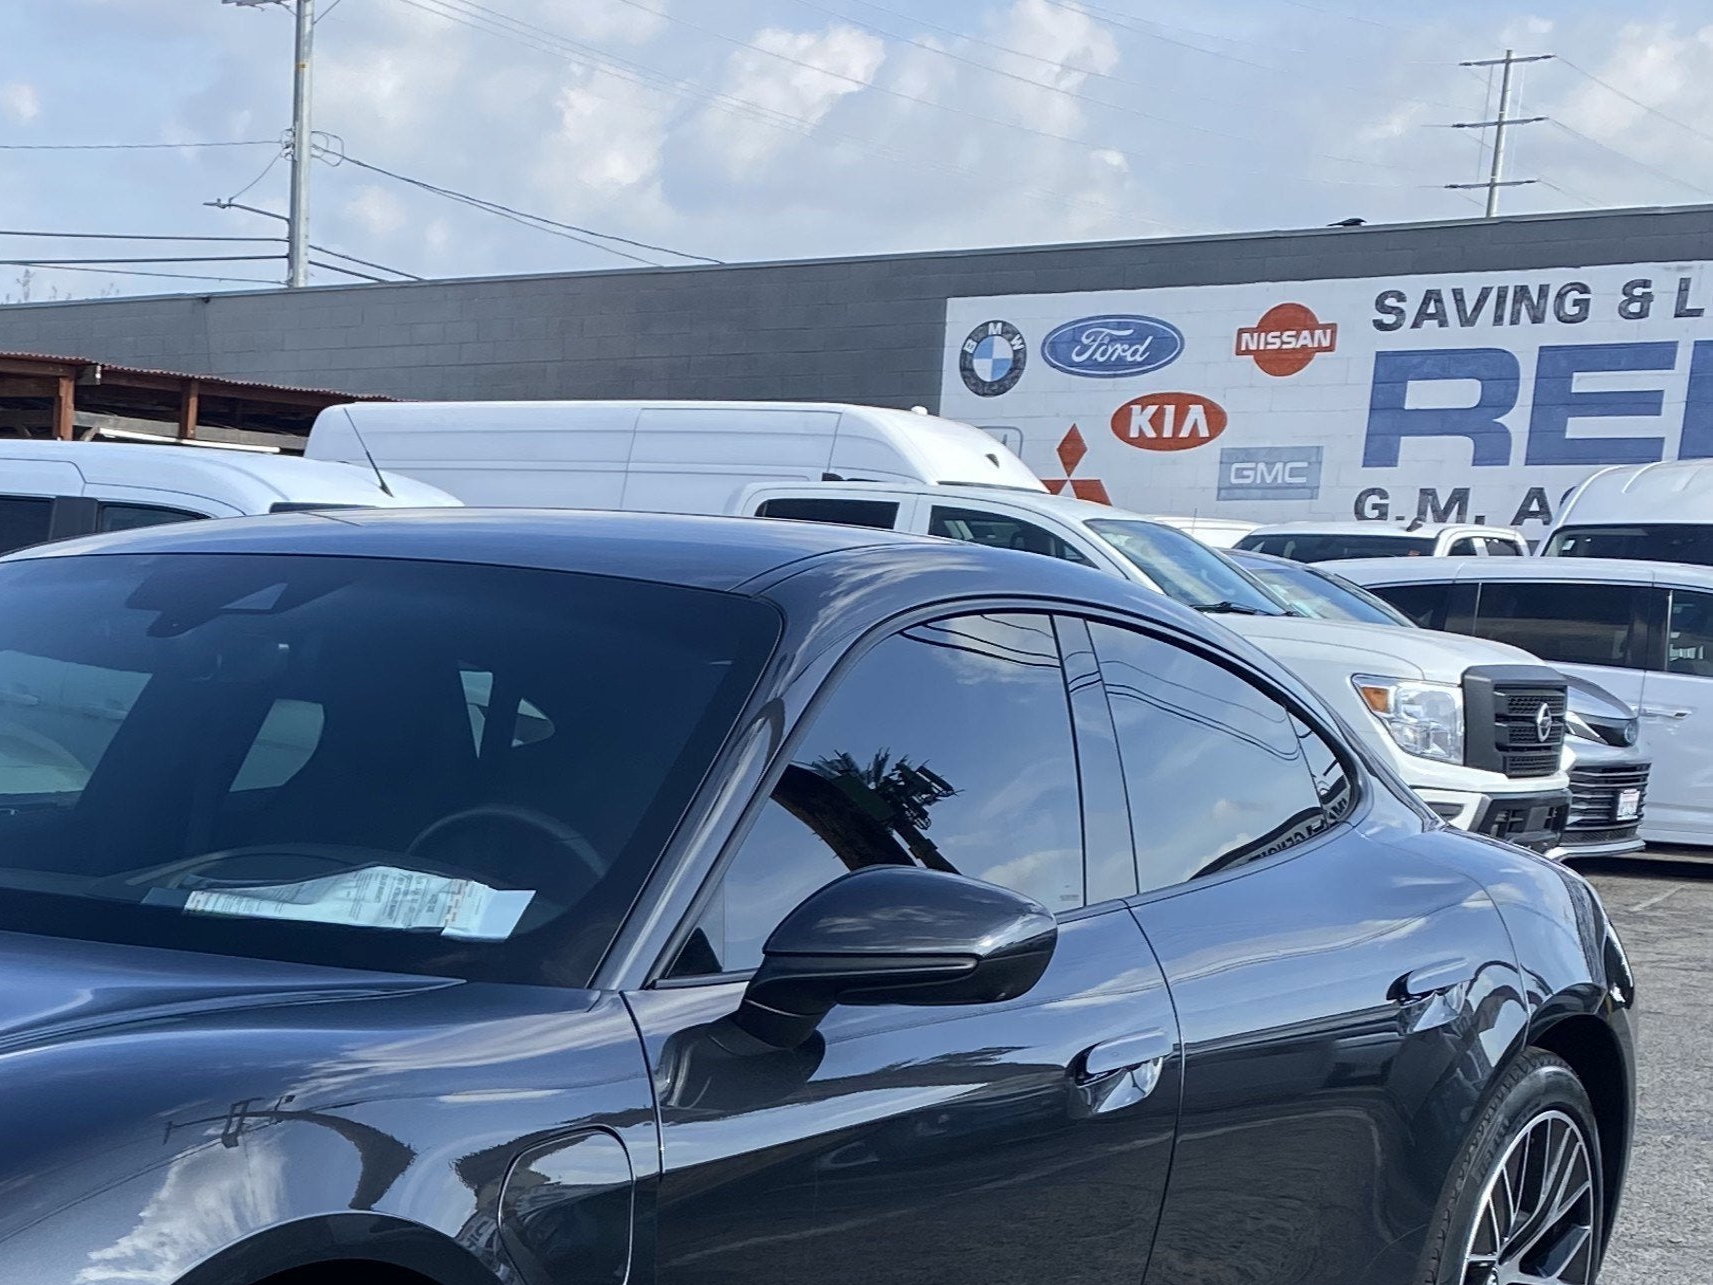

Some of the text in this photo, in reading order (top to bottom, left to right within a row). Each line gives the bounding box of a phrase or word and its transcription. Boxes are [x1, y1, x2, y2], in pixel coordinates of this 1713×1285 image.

[1372, 282, 1591, 331] SAVING
[1618, 278, 1655, 320] &
[963, 322, 1025, 354] BMW
[1071, 327, 1154, 362] Ford
[1240, 329, 1332, 351] NISSAN
[1129, 404, 1210, 438] KIA
[1362, 340, 1713, 468] RE
[1230, 461, 1309, 484] GMC
[1353, 486, 1577, 527] G.M. A
